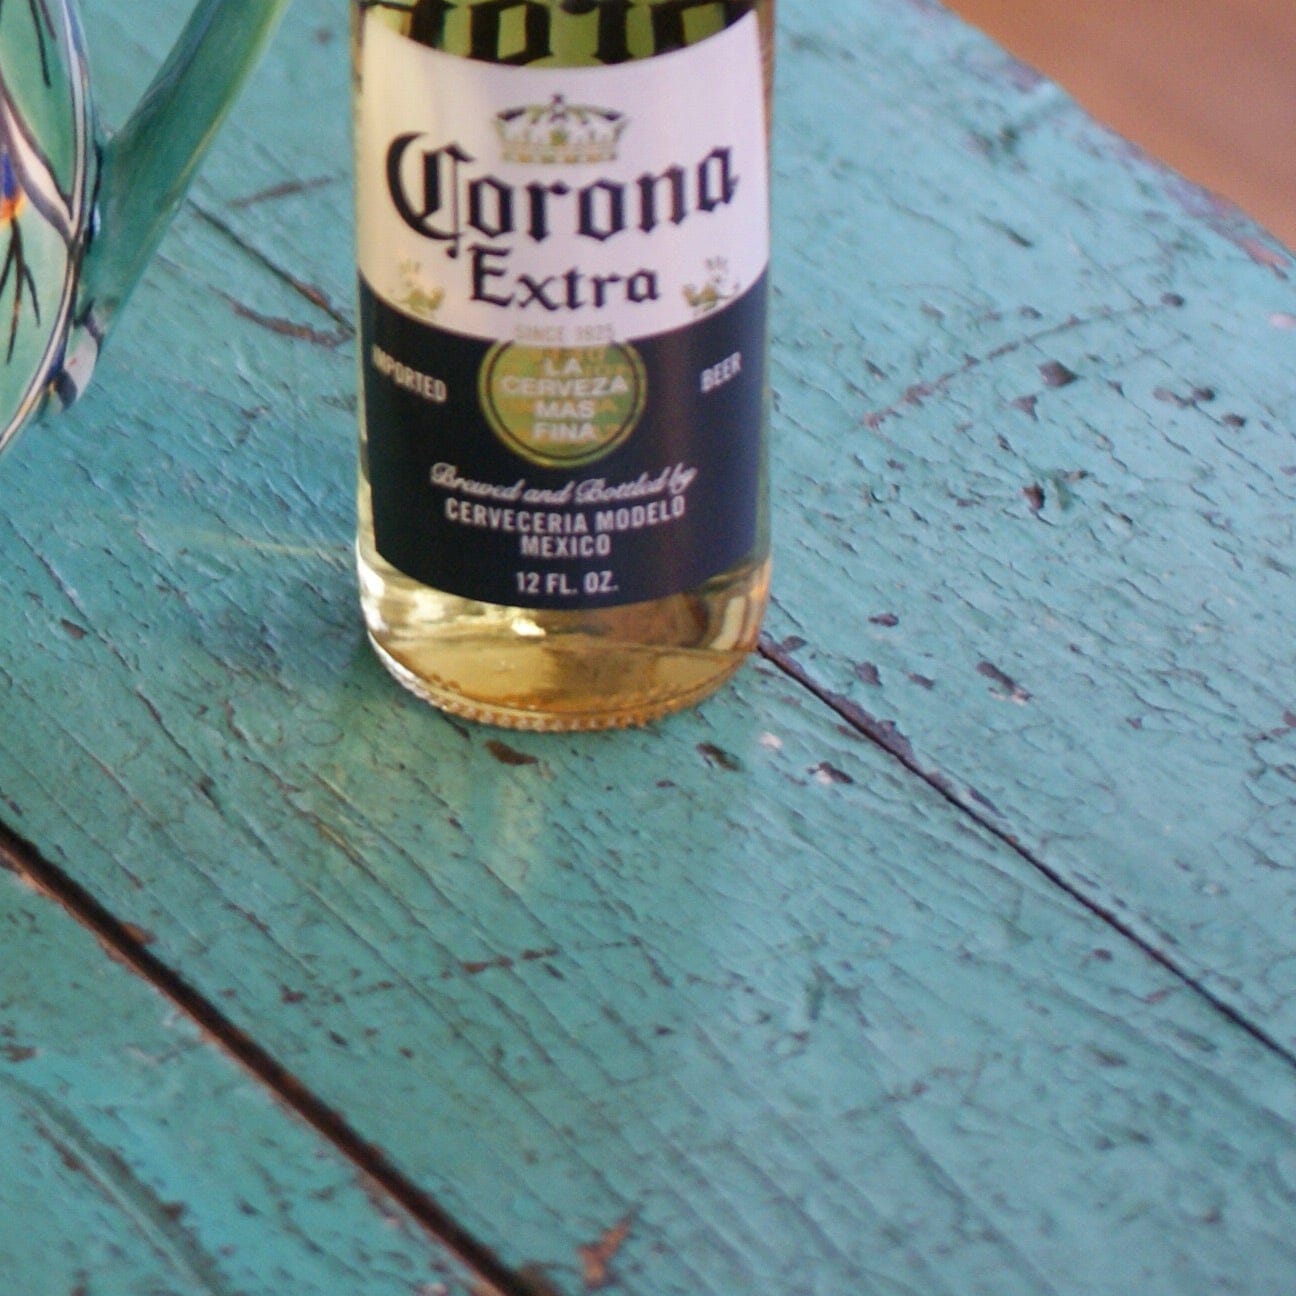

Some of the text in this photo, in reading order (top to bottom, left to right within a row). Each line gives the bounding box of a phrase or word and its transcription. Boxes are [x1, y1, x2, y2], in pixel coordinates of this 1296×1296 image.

[386, 130, 739, 259] Corona
[467, 242, 662, 312] Extra
[542, 357, 583, 376] LA
[700, 351, 742, 393] BEER
[500, 374, 629, 397] CERVEZA
[532, 421, 598, 442] FINA
[430, 461, 699, 504] Brewed and Bottled by
[444, 495, 687, 535] CERVECERIA MODELO
[520, 533, 612, 559] MEXICO
[516, 570, 619, 595] 12 FL. OZ.
